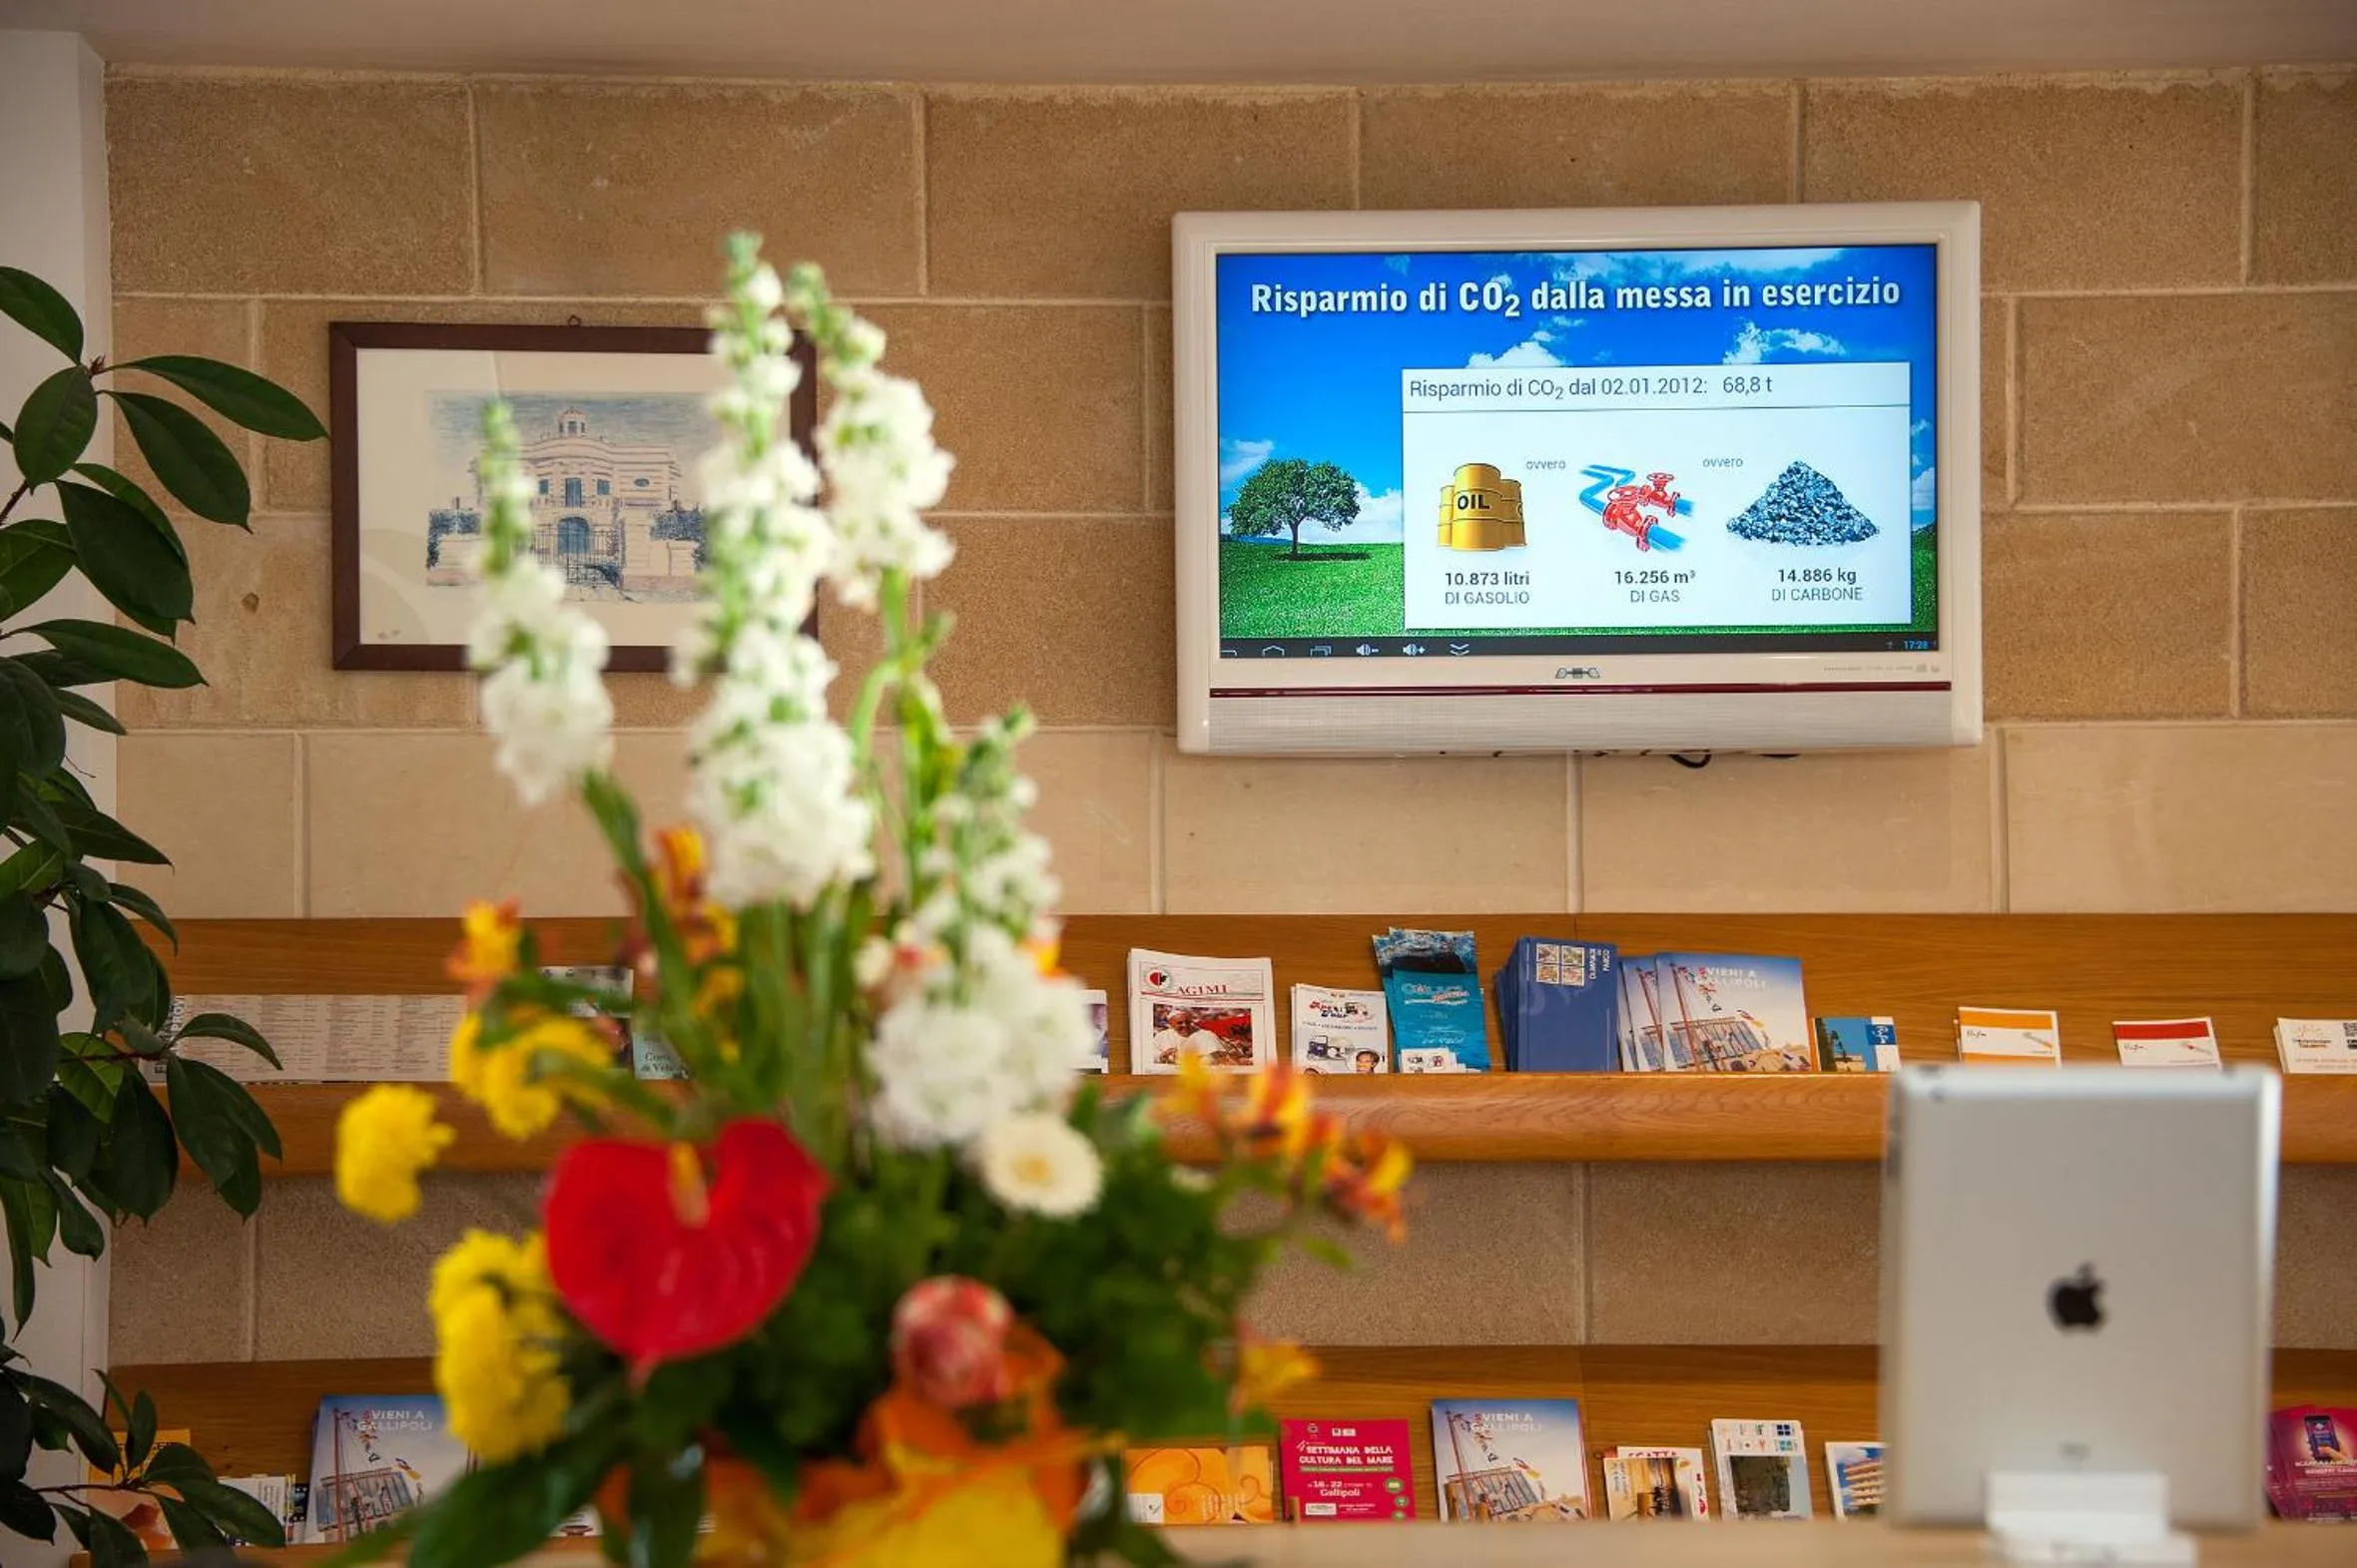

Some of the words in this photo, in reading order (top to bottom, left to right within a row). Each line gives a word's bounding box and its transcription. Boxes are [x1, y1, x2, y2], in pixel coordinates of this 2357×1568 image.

[1251, 282, 1407, 318] Risparmio
[1419, 282, 1447, 312] di
[1530, 280, 1605, 309] dalla
[1615, 285, 1712, 309] messa
[1723, 278, 1751, 307] in
[1762, 275, 1900, 306] esercizio
[1410, 379, 1501, 401] Risparmio
[1506, 378, 1522, 396] di
[1568, 378, 1596, 395] dal
[1601, 377, 1708, 395] 02.01.2012:
[1723, 376, 1761, 396] 68,8
[1766, 376, 1773, 393] t
[1525, 460, 1566, 470] ovvero
[1702, 458, 1744, 468] ovvero
[1458, 494, 1490, 510] OIL
[1445, 572, 1499, 586] 10.873
[1504, 571, 1530, 586] litri
[1614, 570, 1670, 585] 16.256
[1778, 568, 1833, 583] 14.886
[1838, 567, 1857, 585] kg
[1445, 591, 1460, 605] DI
[1464, 591, 1530, 605] GASOLIO
[1630, 590, 1645, 603] DI
[1649, 589, 1680, 603] GAS
[1772, 588, 1786, 602] DI
[1791, 587, 1864, 602] CARBONE
[1706, 966, 1743, 977] VIENI
[370, 1409, 410, 1419] VIENI
[414, 1409, 425, 1419] A
[1481, 1412, 1518, 1421] VIENI
[1523, 1412, 1533, 1421] A
[357, 1420, 433, 1430] GALLIPOLI
[1306, 1445, 1360, 1454] SETTIMANA
[1364, 1445, 1393, 1454] DELLA
[1299, 1455, 1342, 1464] CULTURA
[1346, 1455, 1363, 1464] DEL
[1367, 1455, 1394, 1464] MARE
